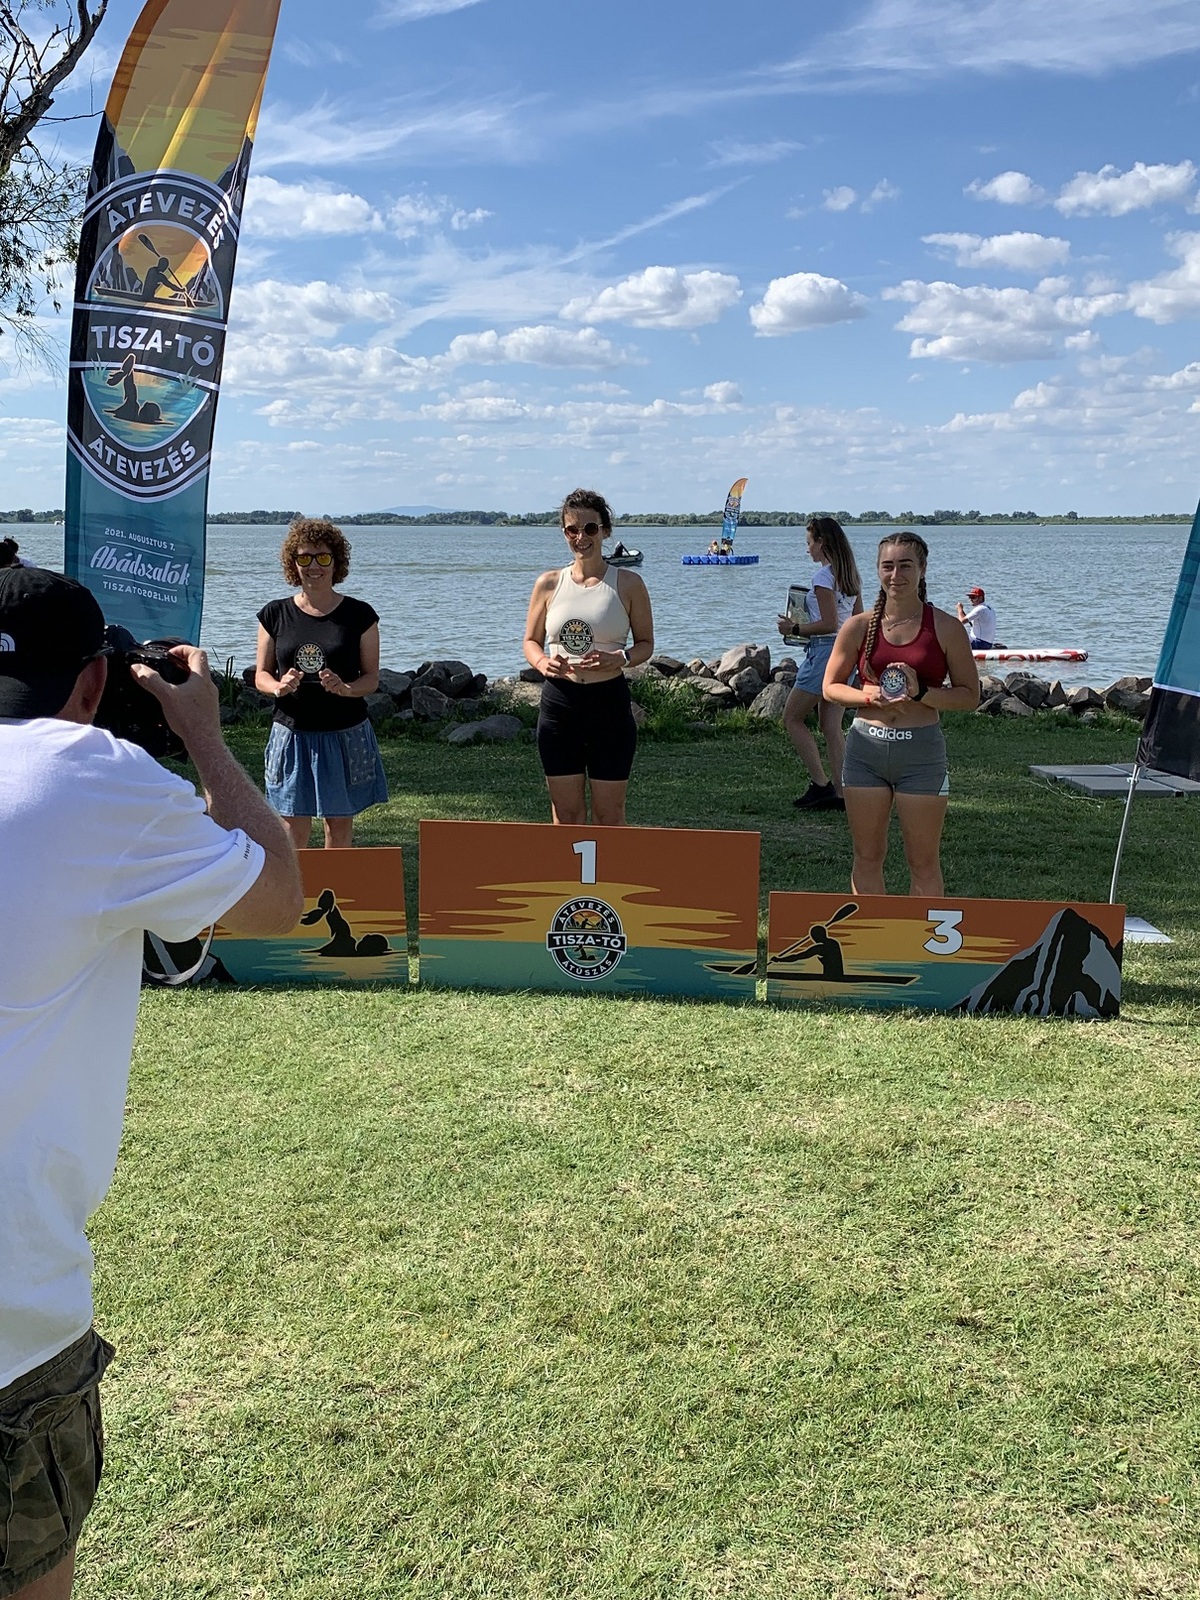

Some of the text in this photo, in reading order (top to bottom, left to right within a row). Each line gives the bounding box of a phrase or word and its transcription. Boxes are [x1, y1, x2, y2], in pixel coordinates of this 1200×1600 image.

[90, 325, 215, 367] TISZA-TÓ
[88, 434, 196, 481] ÁTEVEZÉS
[104, 527, 176, 552] 2021. AUGUSZTUS 7.
[90, 545, 191, 586] Abádszalók
[102, 581, 178, 603] TISZATO2021.HU
[868, 726, 913, 740] adidas
[571, 840, 597, 885] 1
[552, 934, 622, 949] TISZA-TÓ
[922, 909, 964, 956] 3
